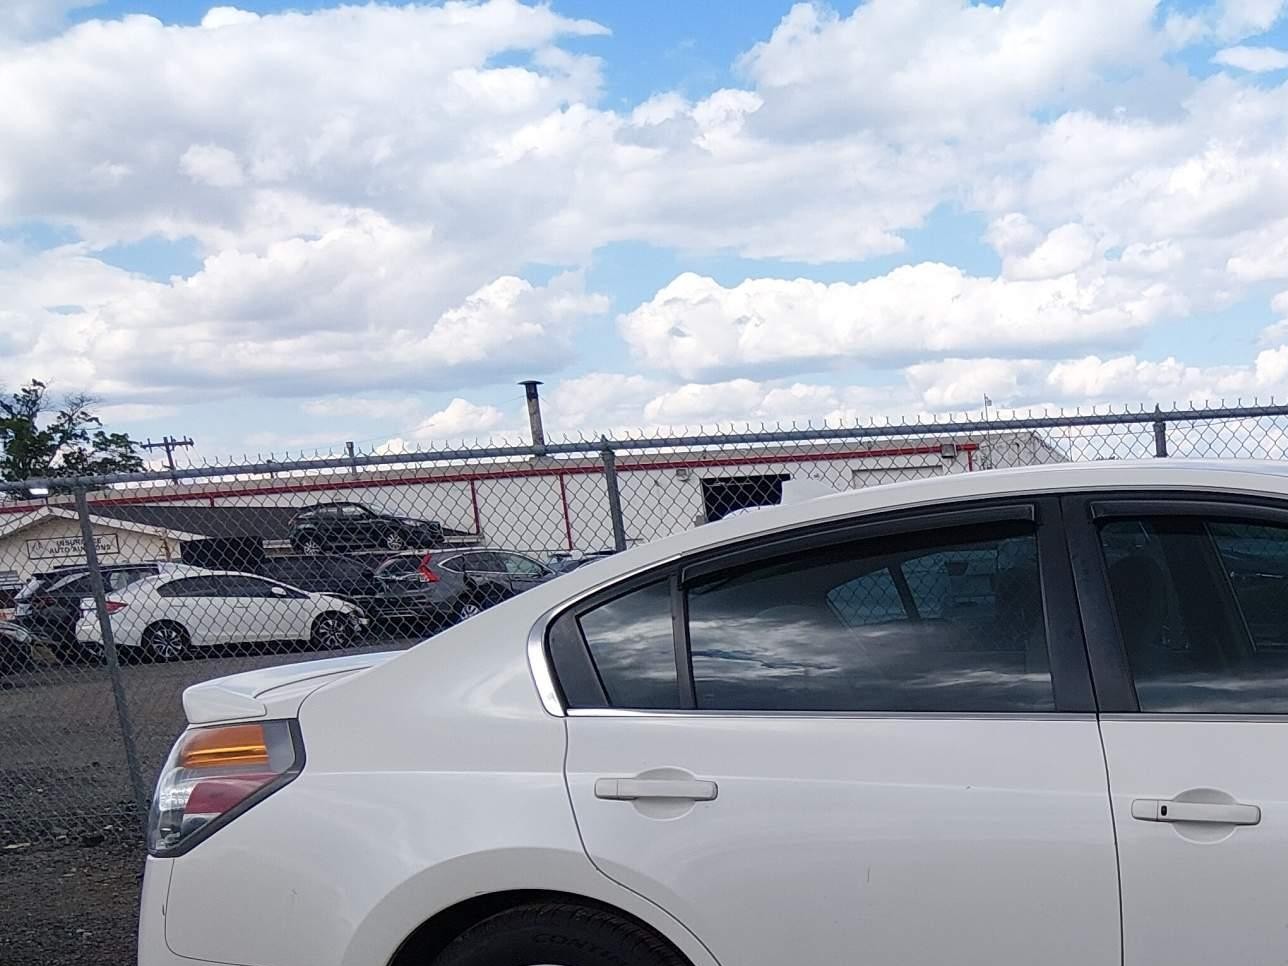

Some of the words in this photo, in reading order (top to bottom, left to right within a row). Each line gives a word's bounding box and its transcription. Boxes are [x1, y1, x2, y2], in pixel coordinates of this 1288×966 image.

[56, 537, 102, 546] INSURCE
[49, 546, 70, 554] AUTO
[72, 543, 111, 553] AUCONS
